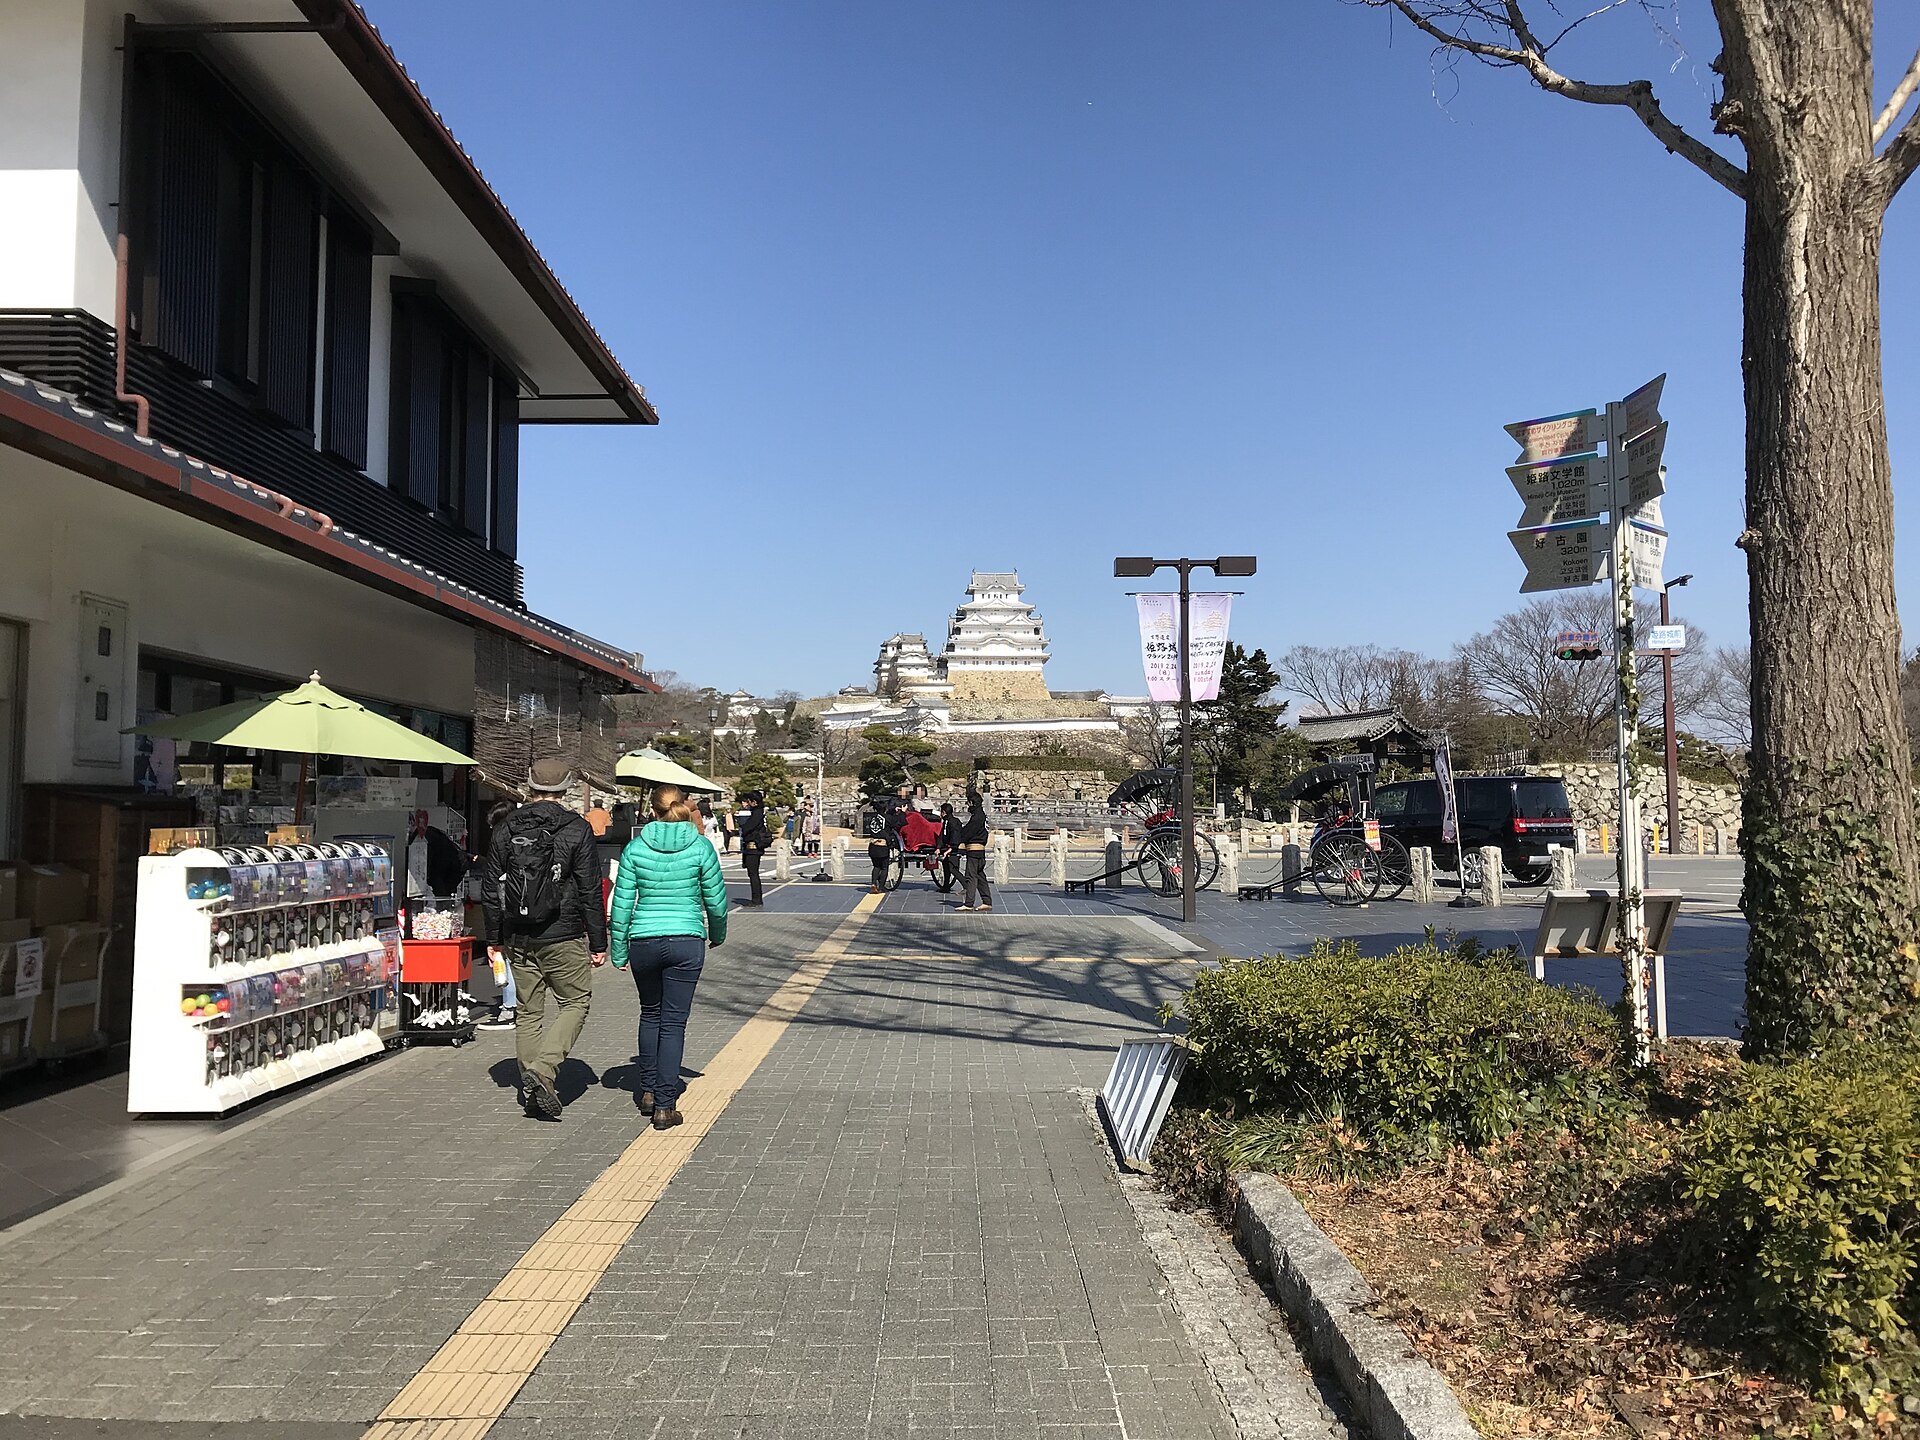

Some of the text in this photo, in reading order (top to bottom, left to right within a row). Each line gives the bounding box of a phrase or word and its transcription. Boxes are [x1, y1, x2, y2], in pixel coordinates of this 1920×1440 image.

[1526, 465, 1585, 485] 姫路文学館
[1557, 488, 1580, 496] Museum
[1560, 493, 1586, 501] Literature
[1560, 545, 1588, 555] 320m
[1563, 558, 1588, 566] Kokoen
[1145, 642, 1178, 653] 姫路城
